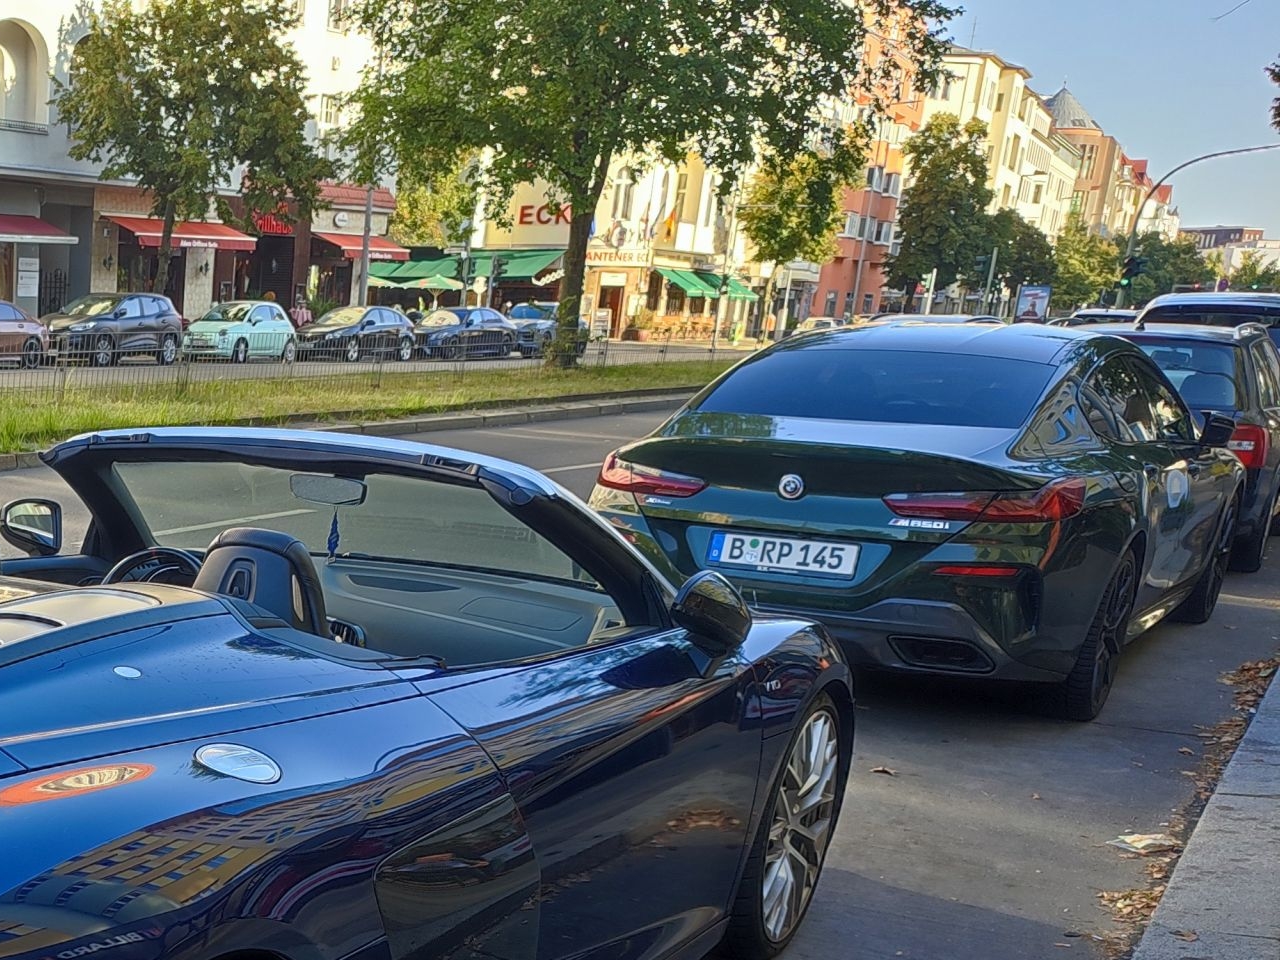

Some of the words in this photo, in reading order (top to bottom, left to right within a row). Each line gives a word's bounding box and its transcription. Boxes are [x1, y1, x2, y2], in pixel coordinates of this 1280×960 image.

[728, 537, 746, 560] B
[759, 541, 793, 564] RP
[795, 544, 846, 569] 145
